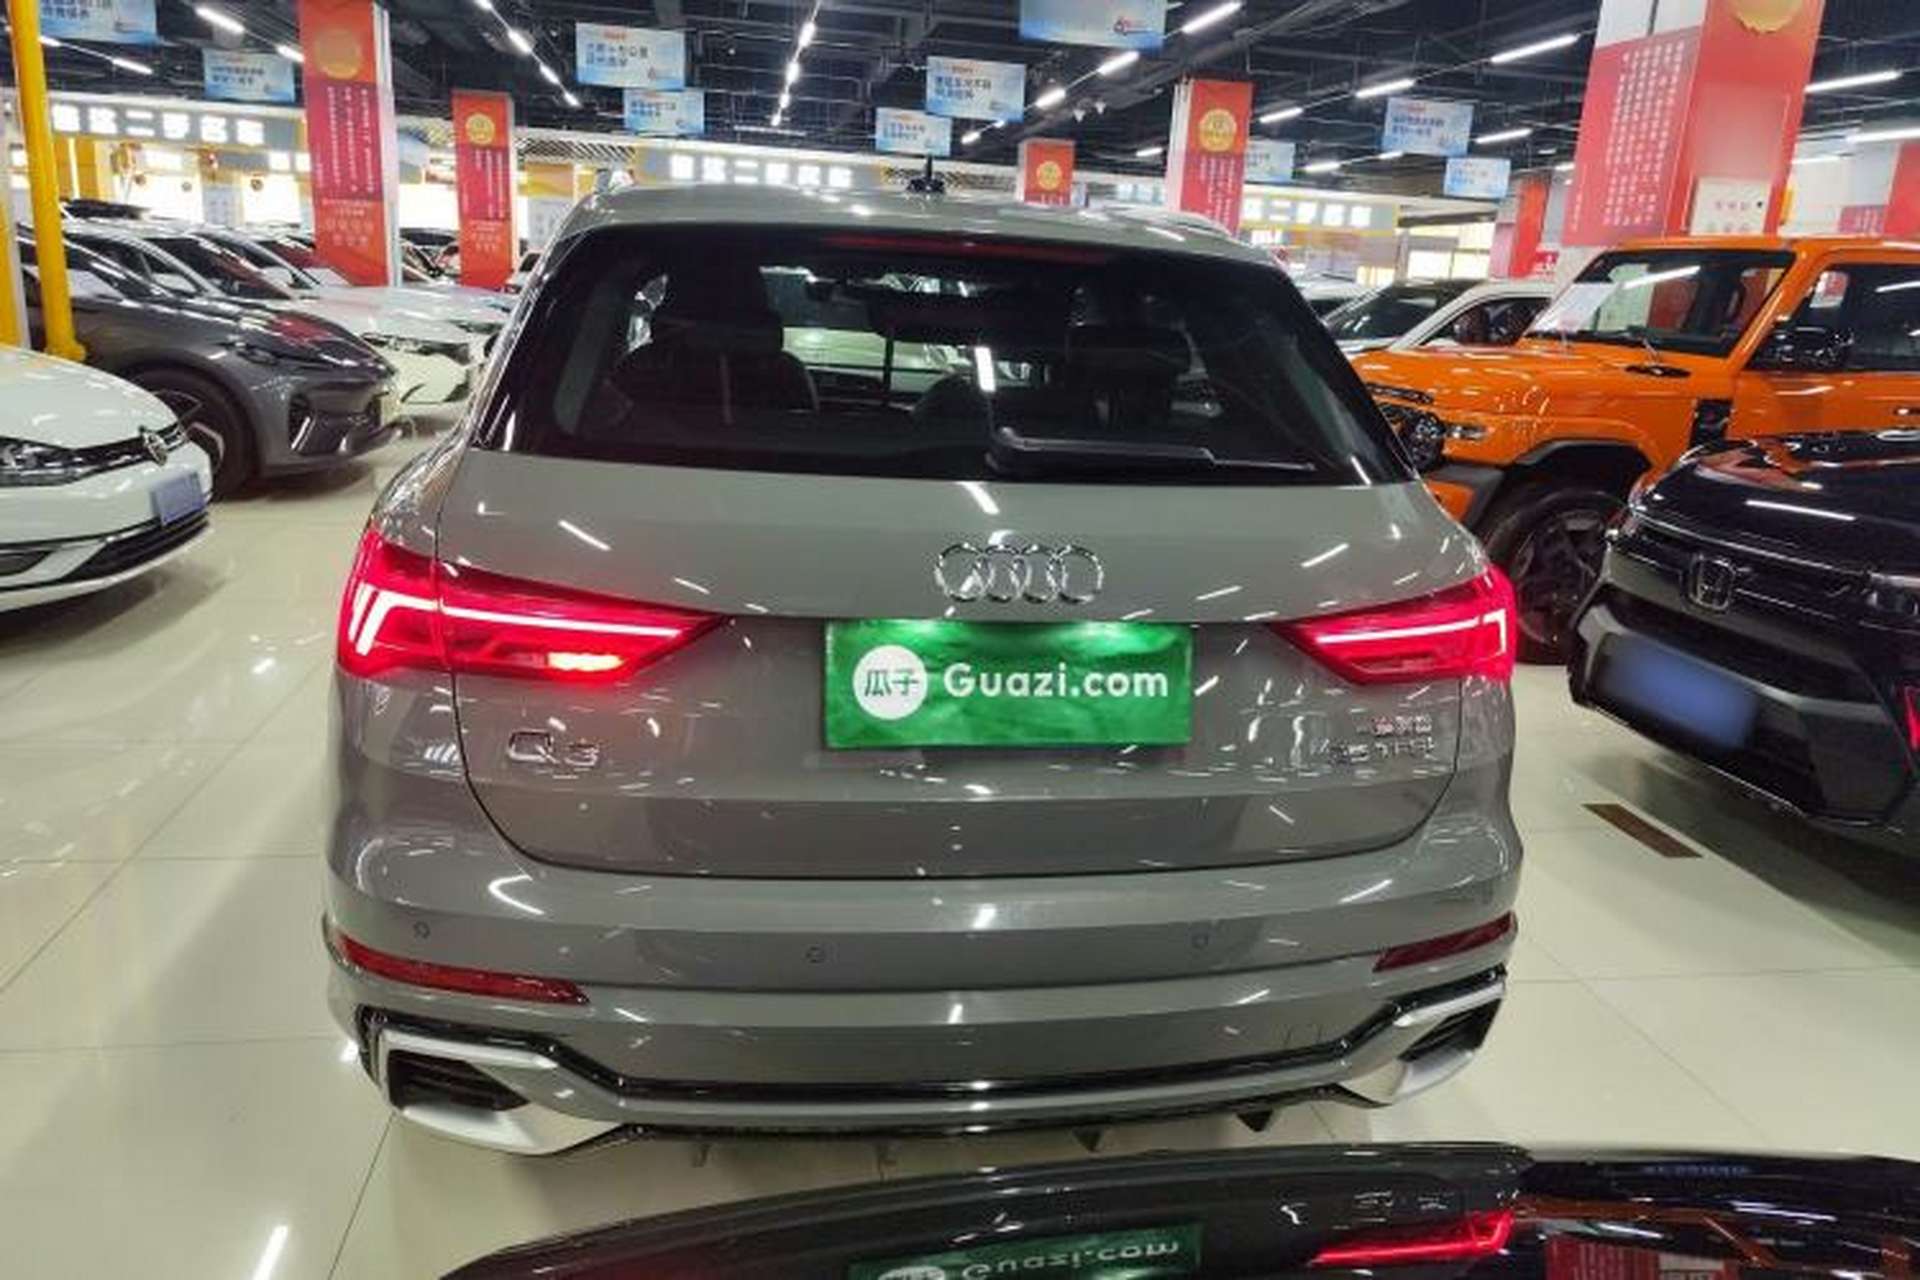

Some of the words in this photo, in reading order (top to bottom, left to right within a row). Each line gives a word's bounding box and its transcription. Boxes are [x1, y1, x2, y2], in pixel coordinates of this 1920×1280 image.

[864, 668, 920, 697] 瓜子
[943, 662, 1169, 698] Guazi.com
[506, 728, 600, 767] Q3
